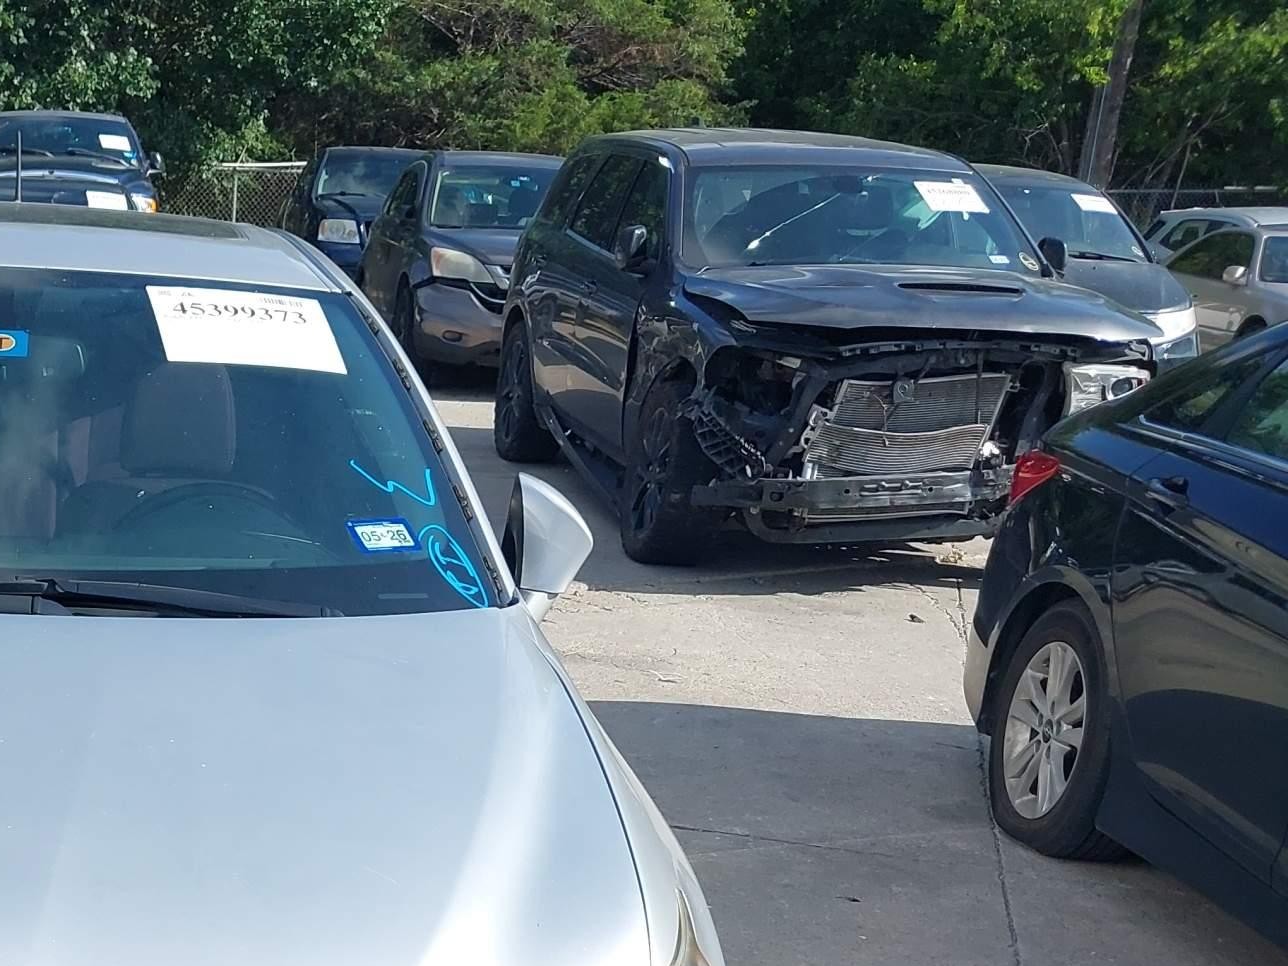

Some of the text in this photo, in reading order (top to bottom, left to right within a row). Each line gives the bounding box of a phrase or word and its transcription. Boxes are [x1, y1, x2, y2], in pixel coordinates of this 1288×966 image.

[172, 300, 307, 325] 45399373
[360, 529, 408, 543] 05 26
